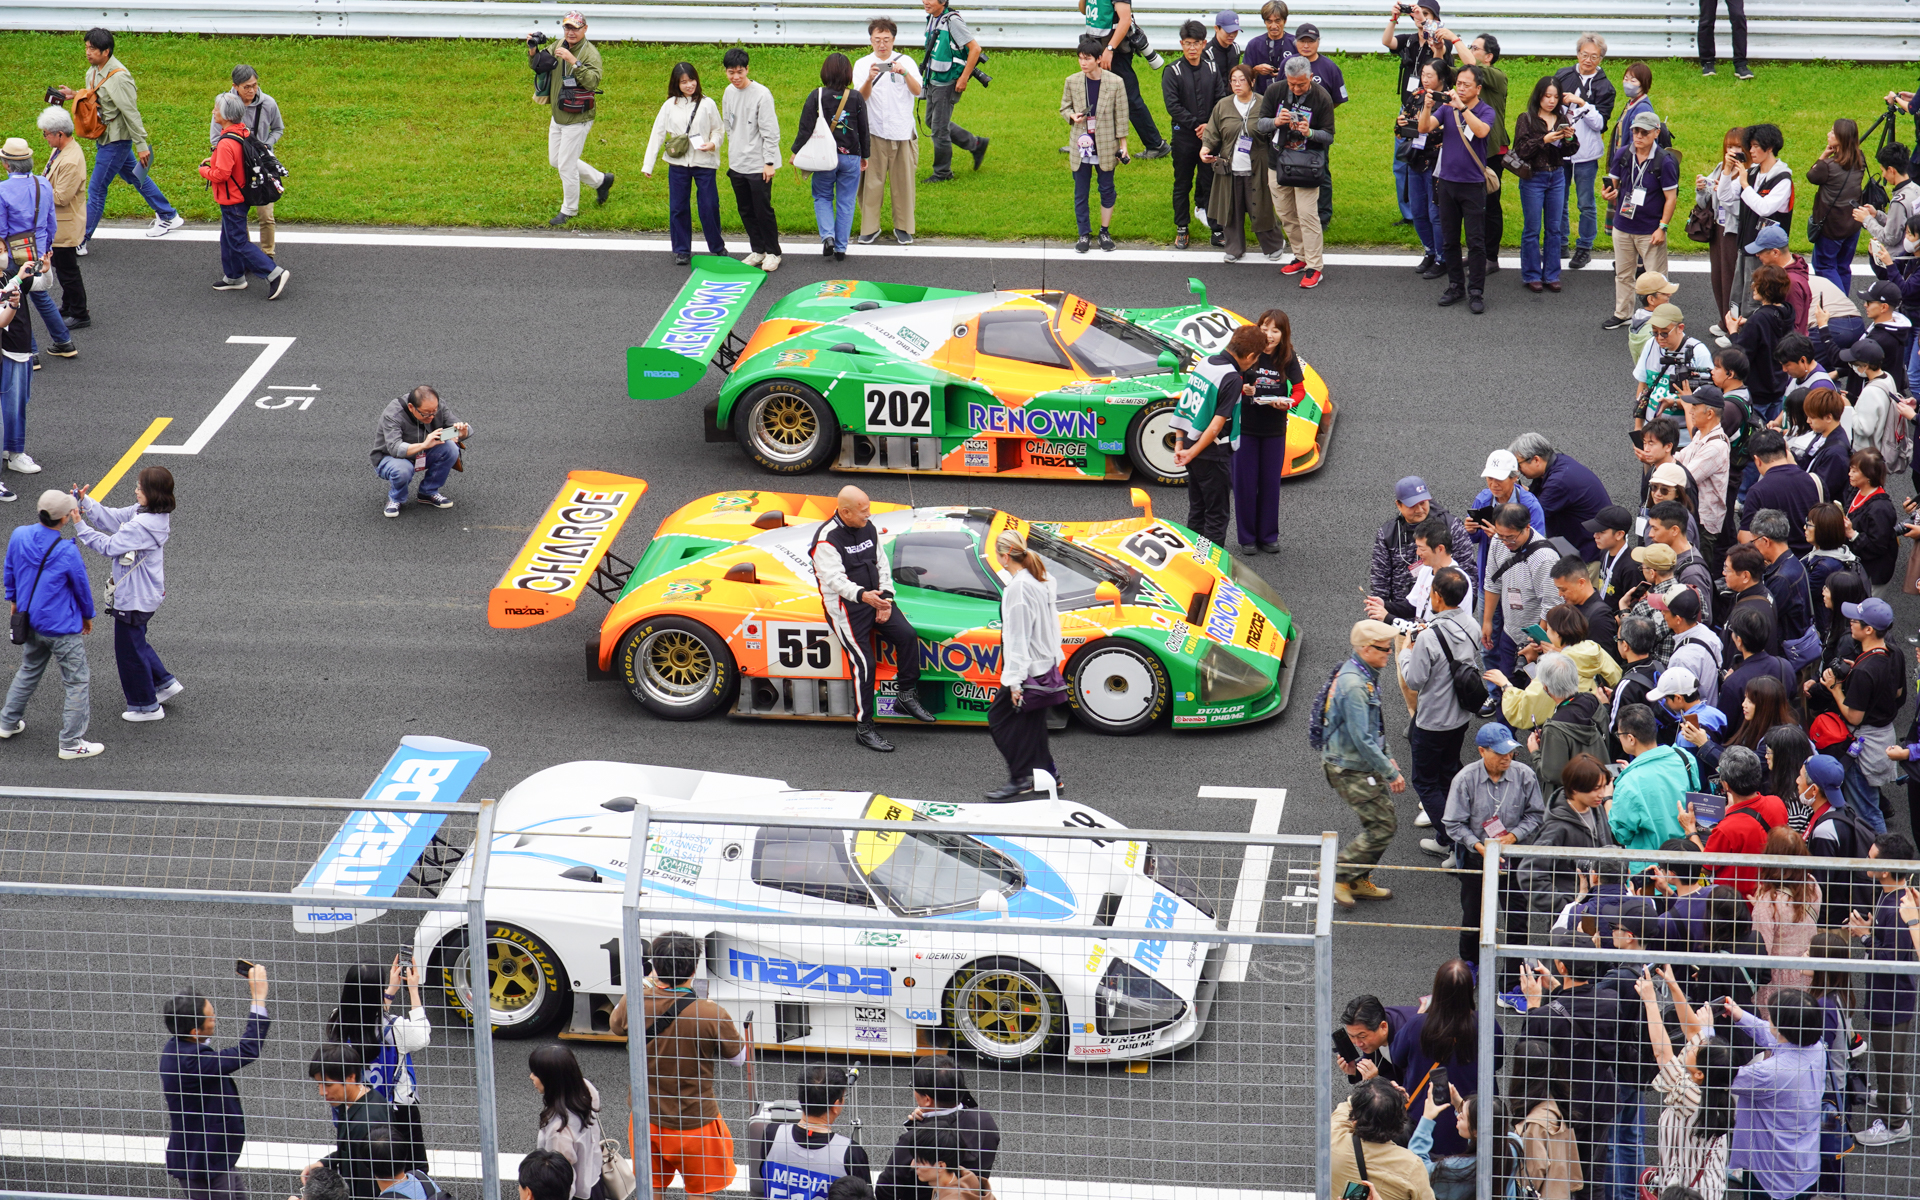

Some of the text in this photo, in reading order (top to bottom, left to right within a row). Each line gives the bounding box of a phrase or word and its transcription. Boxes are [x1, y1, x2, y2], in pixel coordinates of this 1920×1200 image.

[656, 280, 752, 358] RENOWN
[1181, 311, 1238, 348] 202
[864, 321, 896, 340] DUNLOP
[643, 370, 680, 379] mazda
[255, 384, 321, 410] 15
[770, 385, 801, 395] EAGLE
[1114, 397, 1148, 405] IDEMITSU
[867, 389, 930, 427] 202
[1144, 398, 1175, 415] EAGLE
[1179, 386, 1206, 418] 08
[968, 402, 1098, 438] RENOWN
[965, 440, 988, 450] NGK
[1025, 440, 1087, 456] CHARGE
[1030, 455, 1087, 468] mazda
[512, 488, 629, 594] CHARGE
[844, 538, 874, 554] mazda
[1125, 526, 1185, 566] 55
[1191, 534, 1213, 565] CHARGE
[775, 543, 808, 573] DUNLOP
[1207, 576, 1244, 643] RENOWN
[1164, 619, 1189, 654] CHARGE
[1246, 611, 1266, 650] mazda
[778, 628, 832, 669] 55
[876, 633, 1001, 675] RNOW
[712, 661, 725, 695] EAGLE
[882, 681, 900, 692] NG
[952, 682, 1001, 700] CHAR
[1070, 674, 1080, 710] EAGLE
[1182, 715, 1207, 723] brembo
[1196, 705, 1245, 715] DUNLOP
[314, 759, 460, 897] mazda
[662, 828, 714, 845] JOHANSSON
[670, 839, 709, 854] KENNEDY
[609, 859, 660, 876] DUOP
[680, 852, 704, 864] SALA
[308, 913, 353, 921] mazda
[493, 927, 558, 992] DUNLOP
[729, 948, 892, 996] mazda
[855, 1007, 886, 1020] NGK
[1099, 1032, 1155, 1044] DUNLOP
[1083, 1046, 1112, 1055] brembo
[772, 1167, 829, 1194] MEDIA
